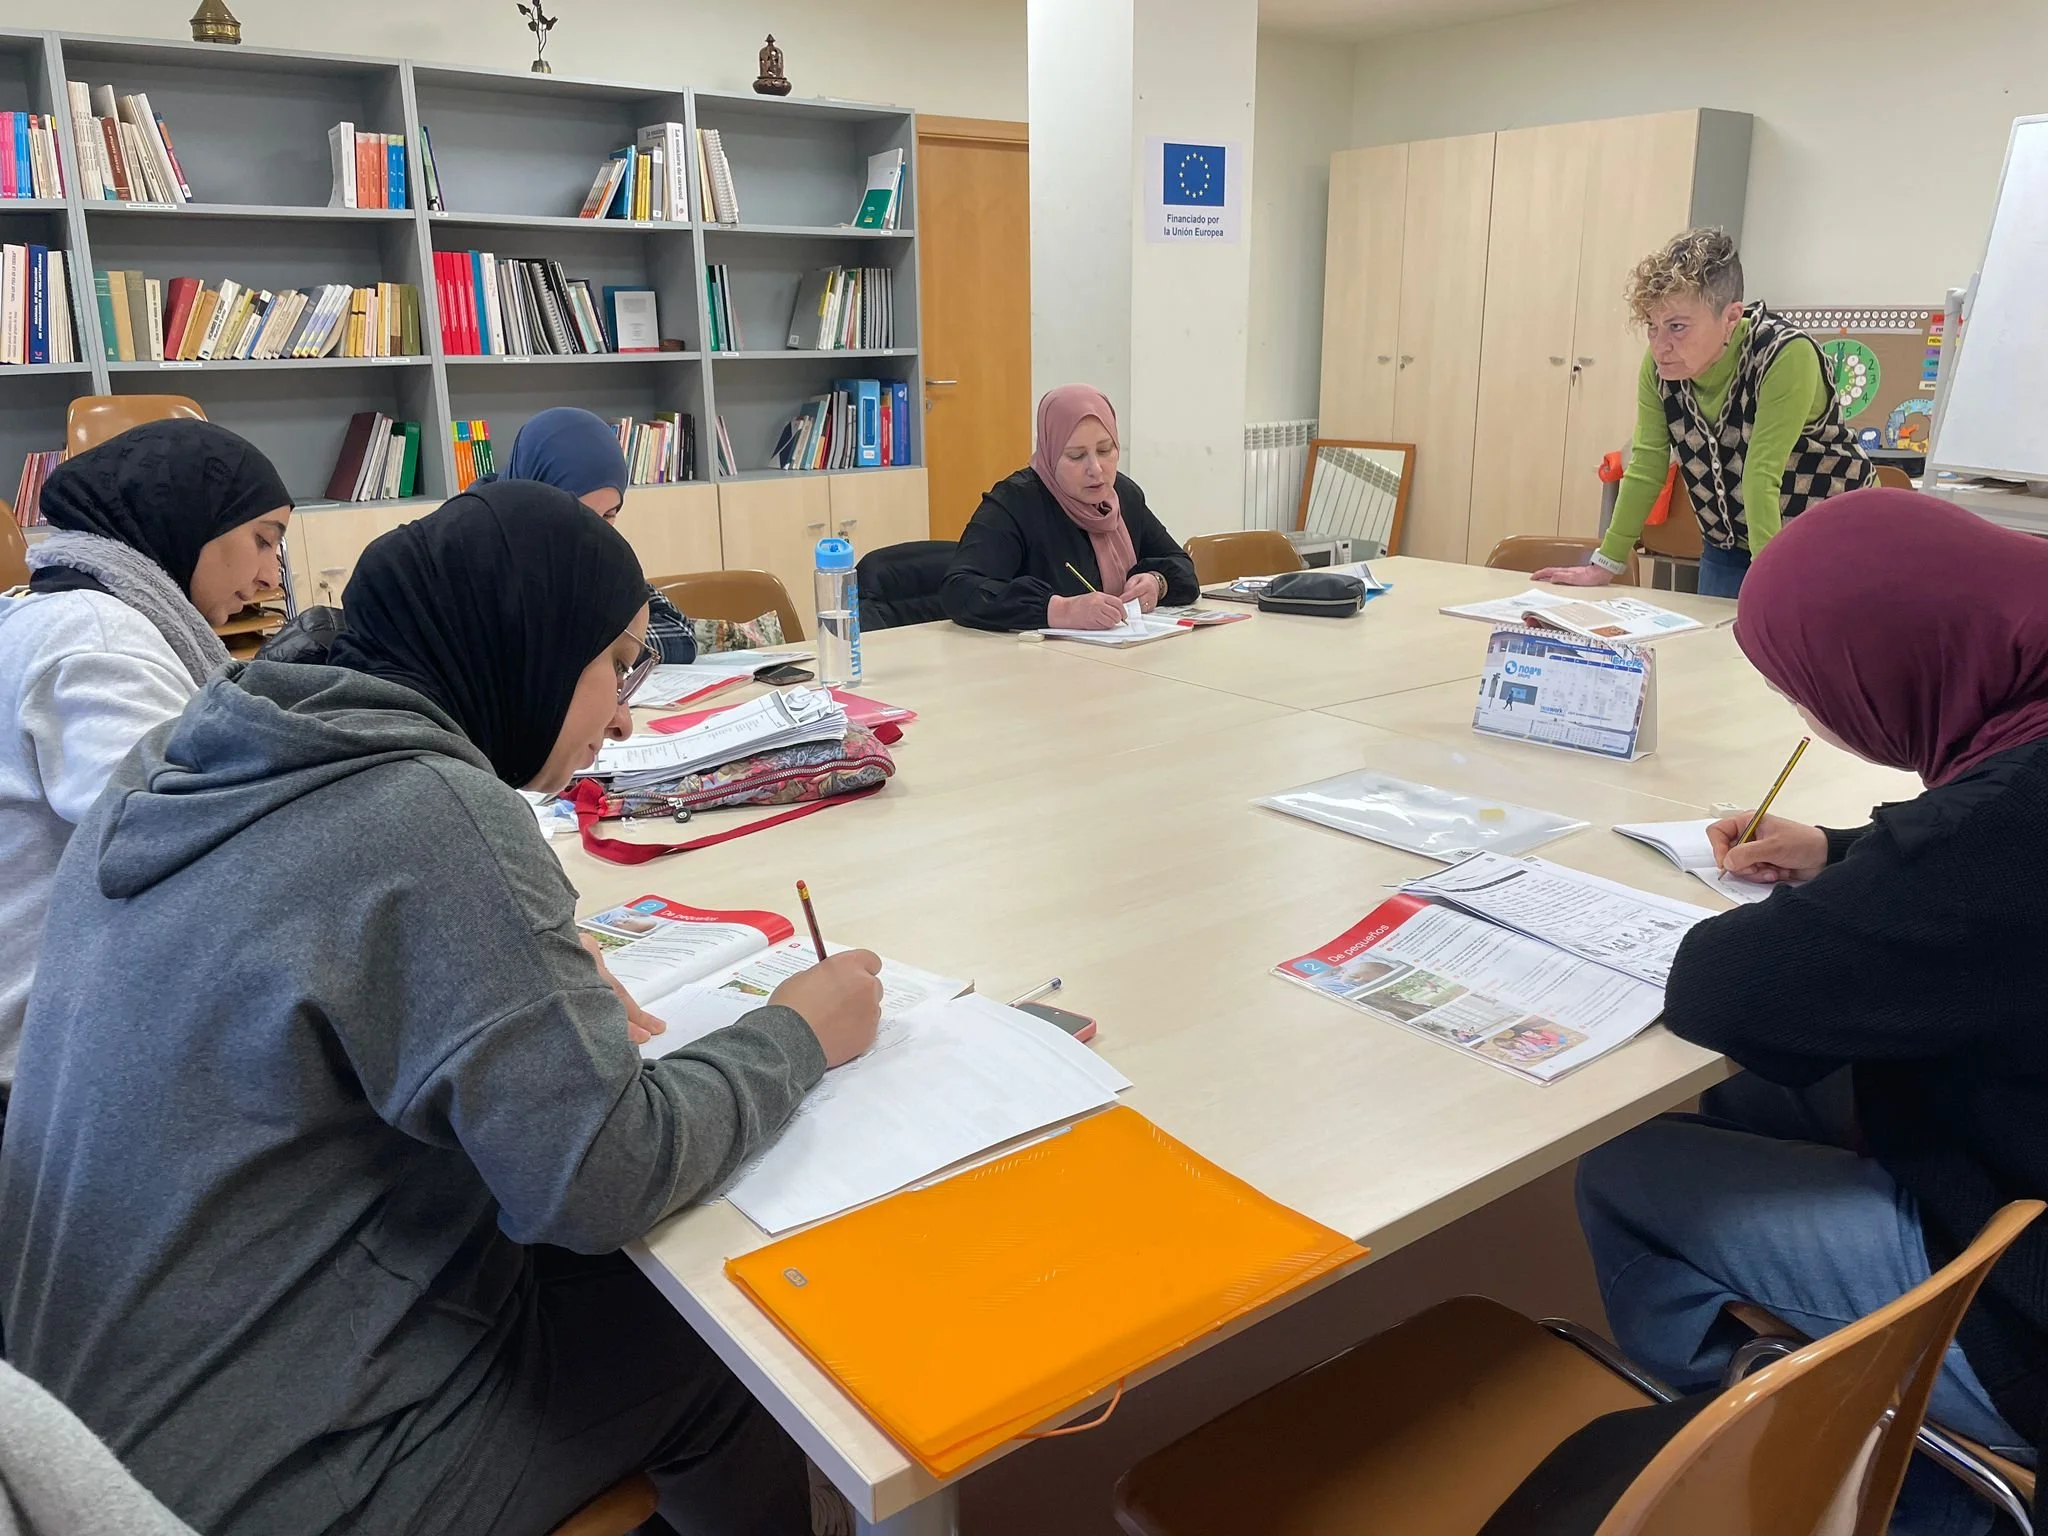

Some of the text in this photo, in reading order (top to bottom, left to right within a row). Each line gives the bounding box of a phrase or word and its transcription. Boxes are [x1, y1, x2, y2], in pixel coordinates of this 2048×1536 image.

[1166, 214, 1220, 226] Financiado por
[1163, 227, 1224, 238] la Unión Europea
[1836, 342, 1845, 351] 12
[1856, 347, 1862, 356] 1
[1868, 358, 1875, 370] 2
[1869, 375, 1876, 384] 3
[1861, 391, 1869, 403] 4
[1845, 406, 1852, 418] 5
[640, 903, 657, 911] 2
[1328, 953, 1346, 963] De
[1344, 924, 1390, 957] pequeños
[1304, 962, 1321, 972] 2
